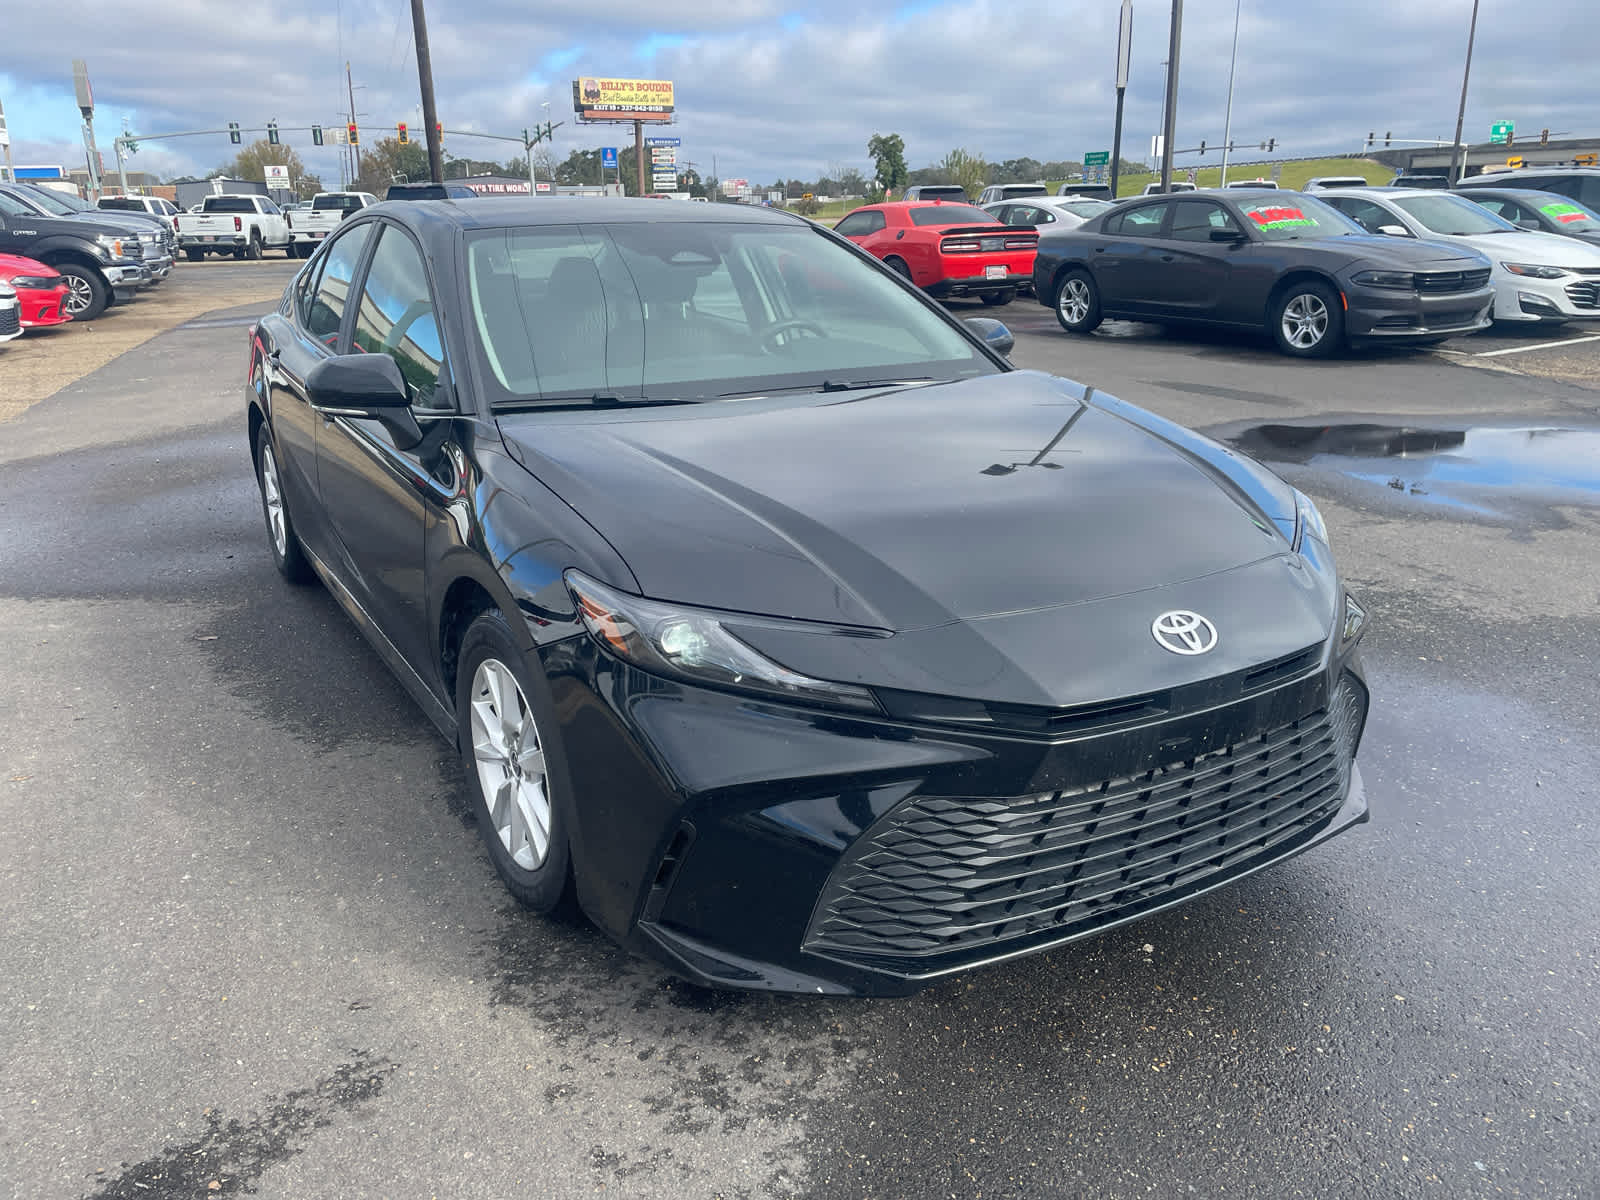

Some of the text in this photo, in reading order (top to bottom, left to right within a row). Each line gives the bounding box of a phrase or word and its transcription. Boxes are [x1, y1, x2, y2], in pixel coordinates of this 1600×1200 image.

[600, 82, 672, 92] BILLY'S BOUDIN
[487, 184, 504, 192] TIRE
